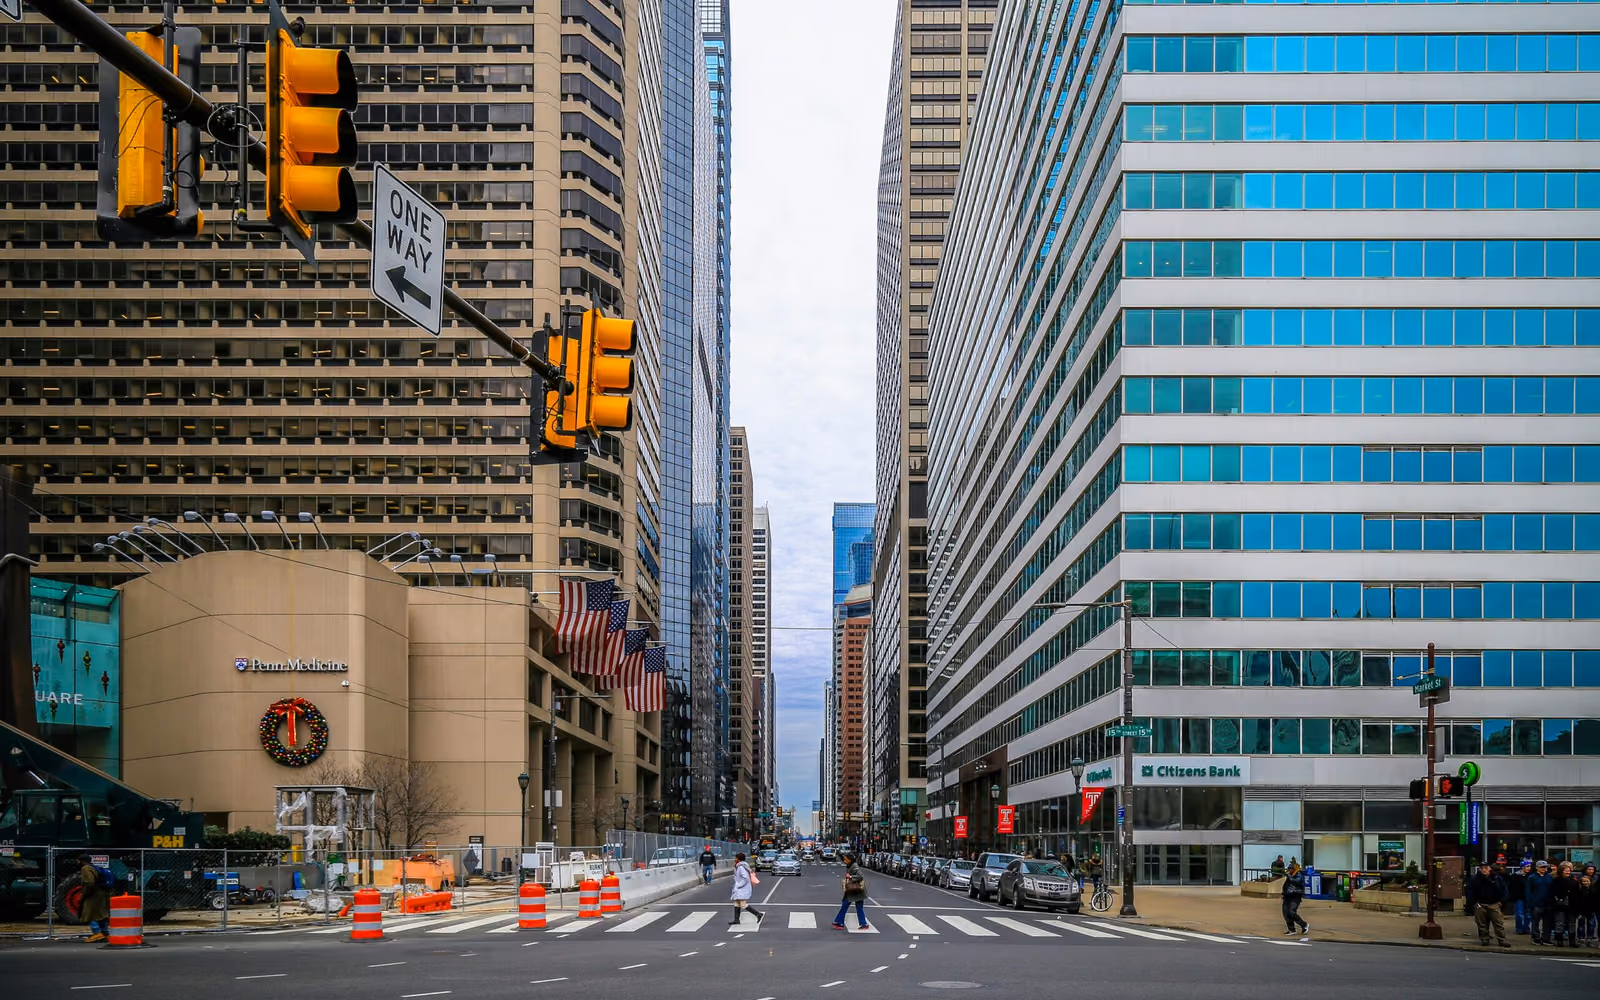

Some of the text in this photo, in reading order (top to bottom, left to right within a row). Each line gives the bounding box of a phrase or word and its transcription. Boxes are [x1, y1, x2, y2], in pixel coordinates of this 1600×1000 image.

[390, 189, 432, 244] ONE
[387, 219, 433, 274] WAY
[251, 657, 348, 671] Penn Medicine
[1414, 678, 1441, 693] Market St
[1157, 765, 1240, 777] Citizens Bank
[152, 835, 184, 848] P&H
